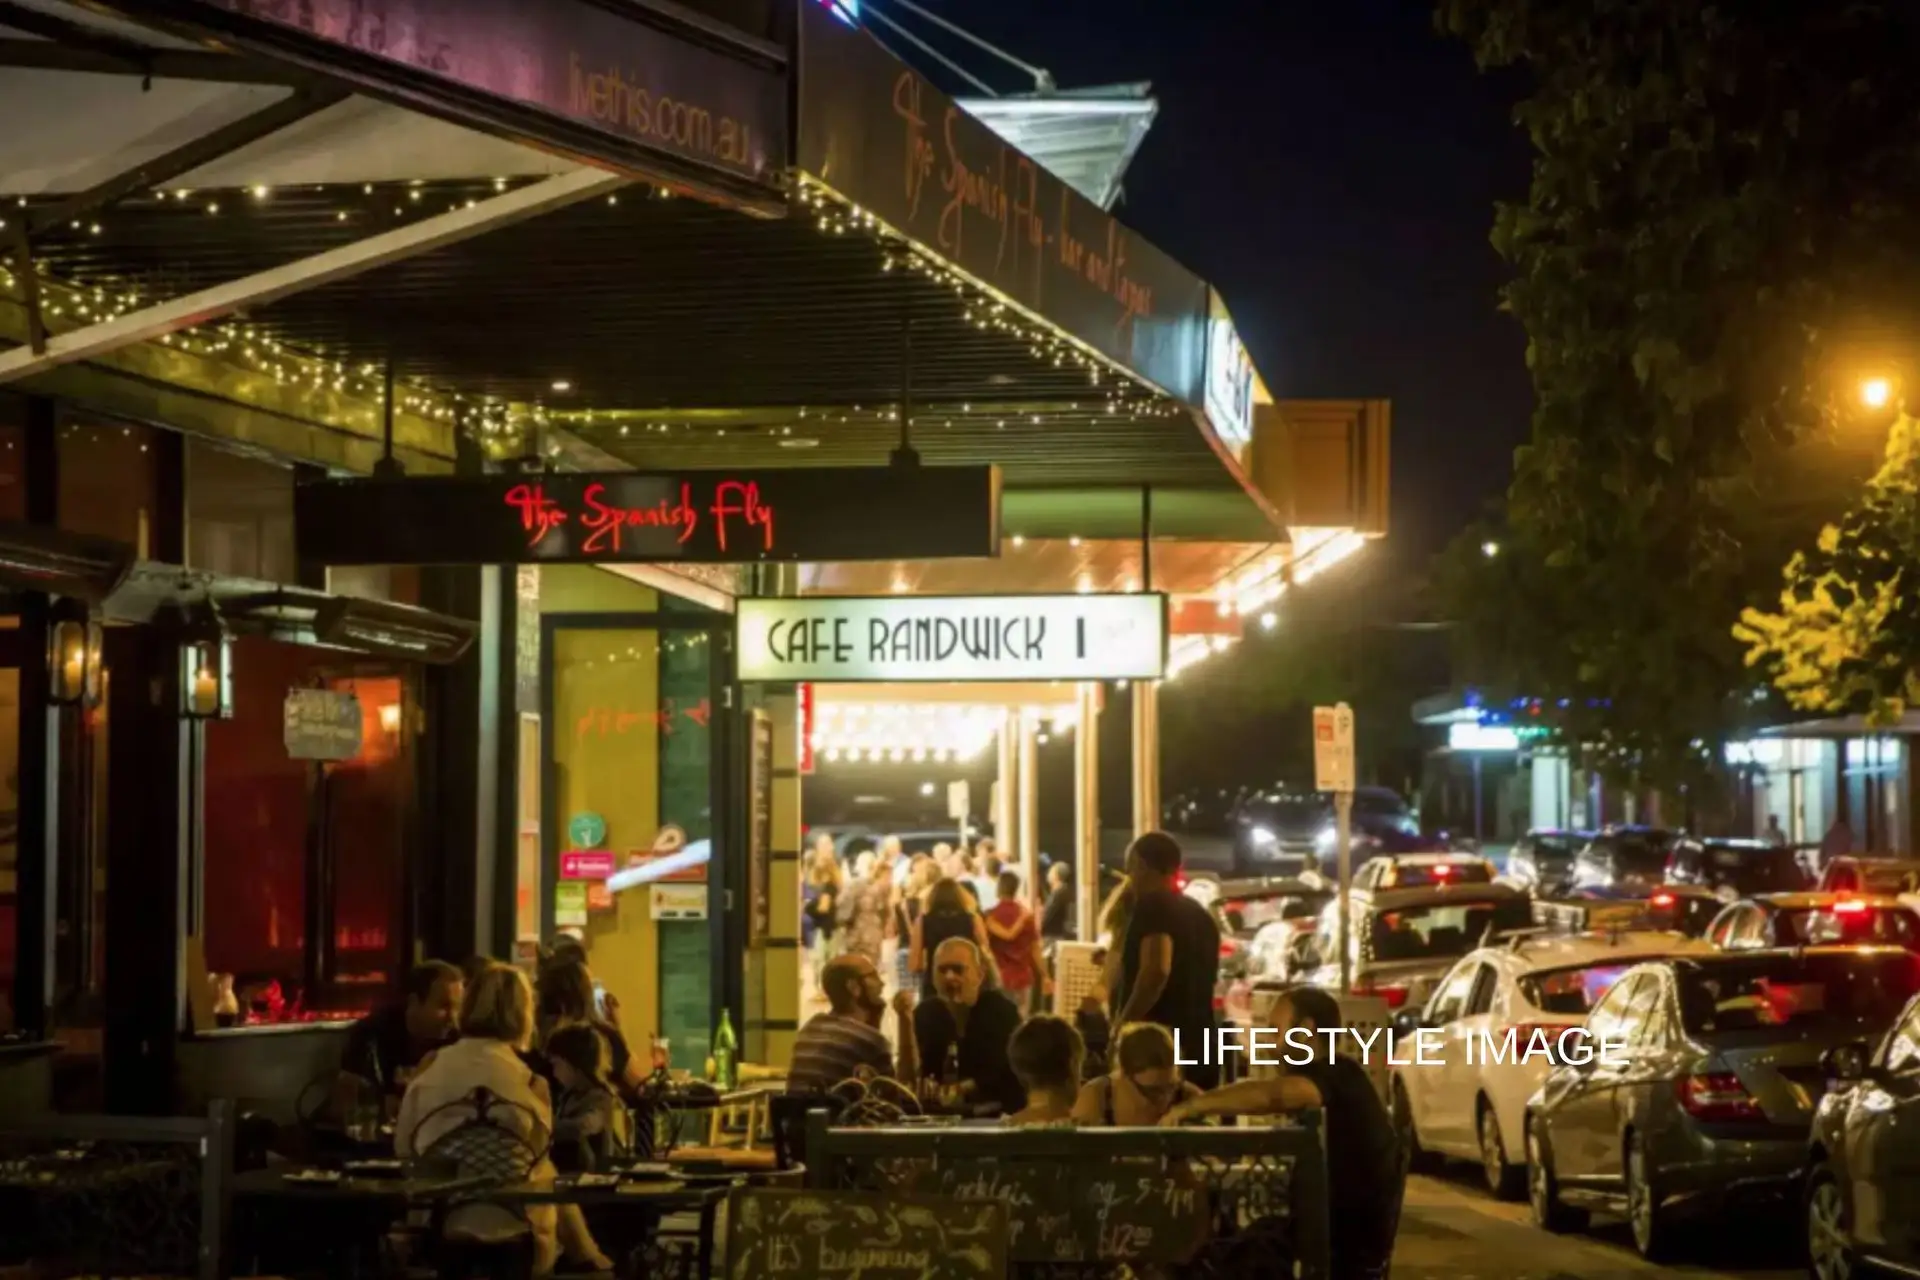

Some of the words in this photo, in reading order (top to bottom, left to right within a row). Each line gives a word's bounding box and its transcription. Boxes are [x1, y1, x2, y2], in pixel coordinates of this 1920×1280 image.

[504, 484, 567, 546] The
[580, 484, 696, 552] Spanish
[709, 481, 773, 551] Fly
[767, 617, 854, 663] CAFE
[868, 614, 1046, 662] RANDWICK
